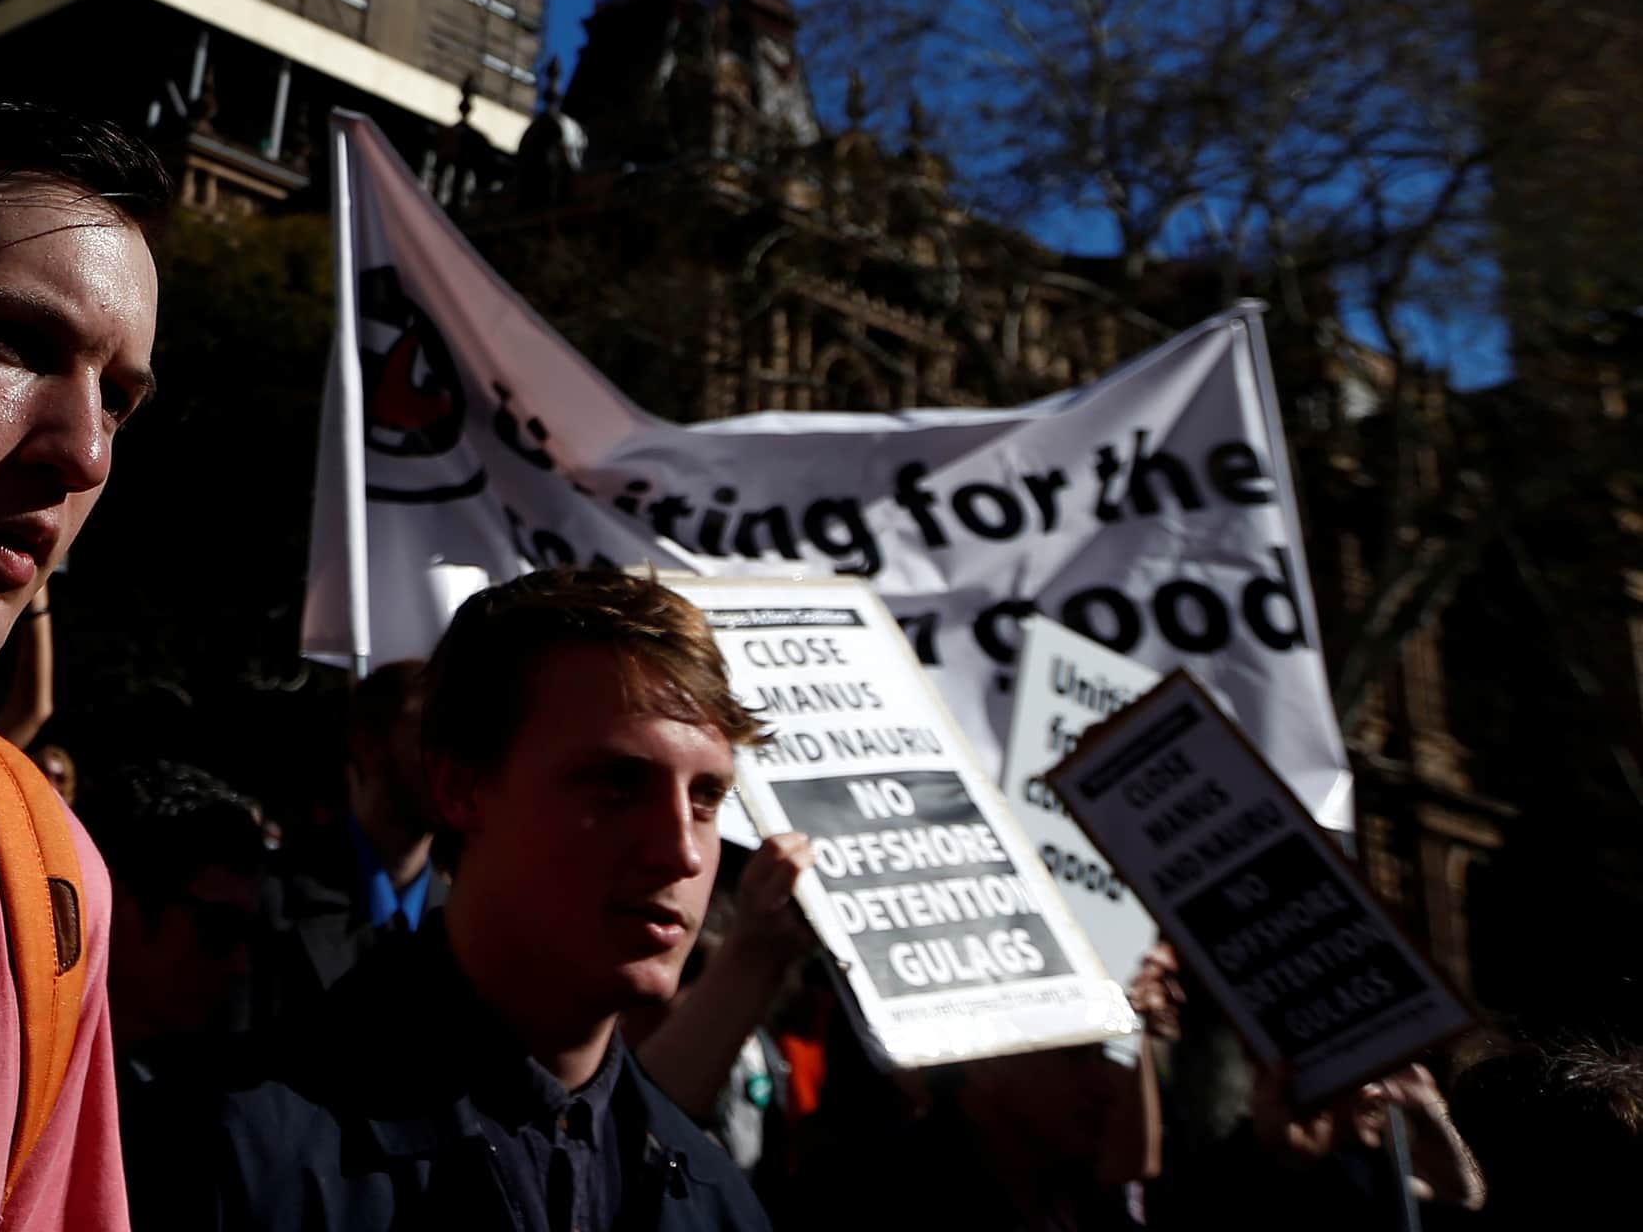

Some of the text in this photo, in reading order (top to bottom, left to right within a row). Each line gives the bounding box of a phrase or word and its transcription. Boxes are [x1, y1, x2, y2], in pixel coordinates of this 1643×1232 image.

[892, 458, 1069, 551] for
[1094, 427, 1279, 525] the
[973, 544, 1309, 694] good
[743, 637, 851, 669] CLOSE
[756, 681, 886, 714] MANUS
[753, 727, 945, 769] AND NAURU
[846, 777, 917, 819] NO
[813, 823, 1009, 880] OFFSHORE
[827, 873, 1046, 935] DETENTION
[1221, 872, 1271, 912] NO
[1212, 879, 1349, 973] OFFSHORE
[888, 927, 1046, 988] GULAGS
[1244, 917, 1388, 1013] DETENTION
[1284, 963, 1398, 1042] GULAGS
